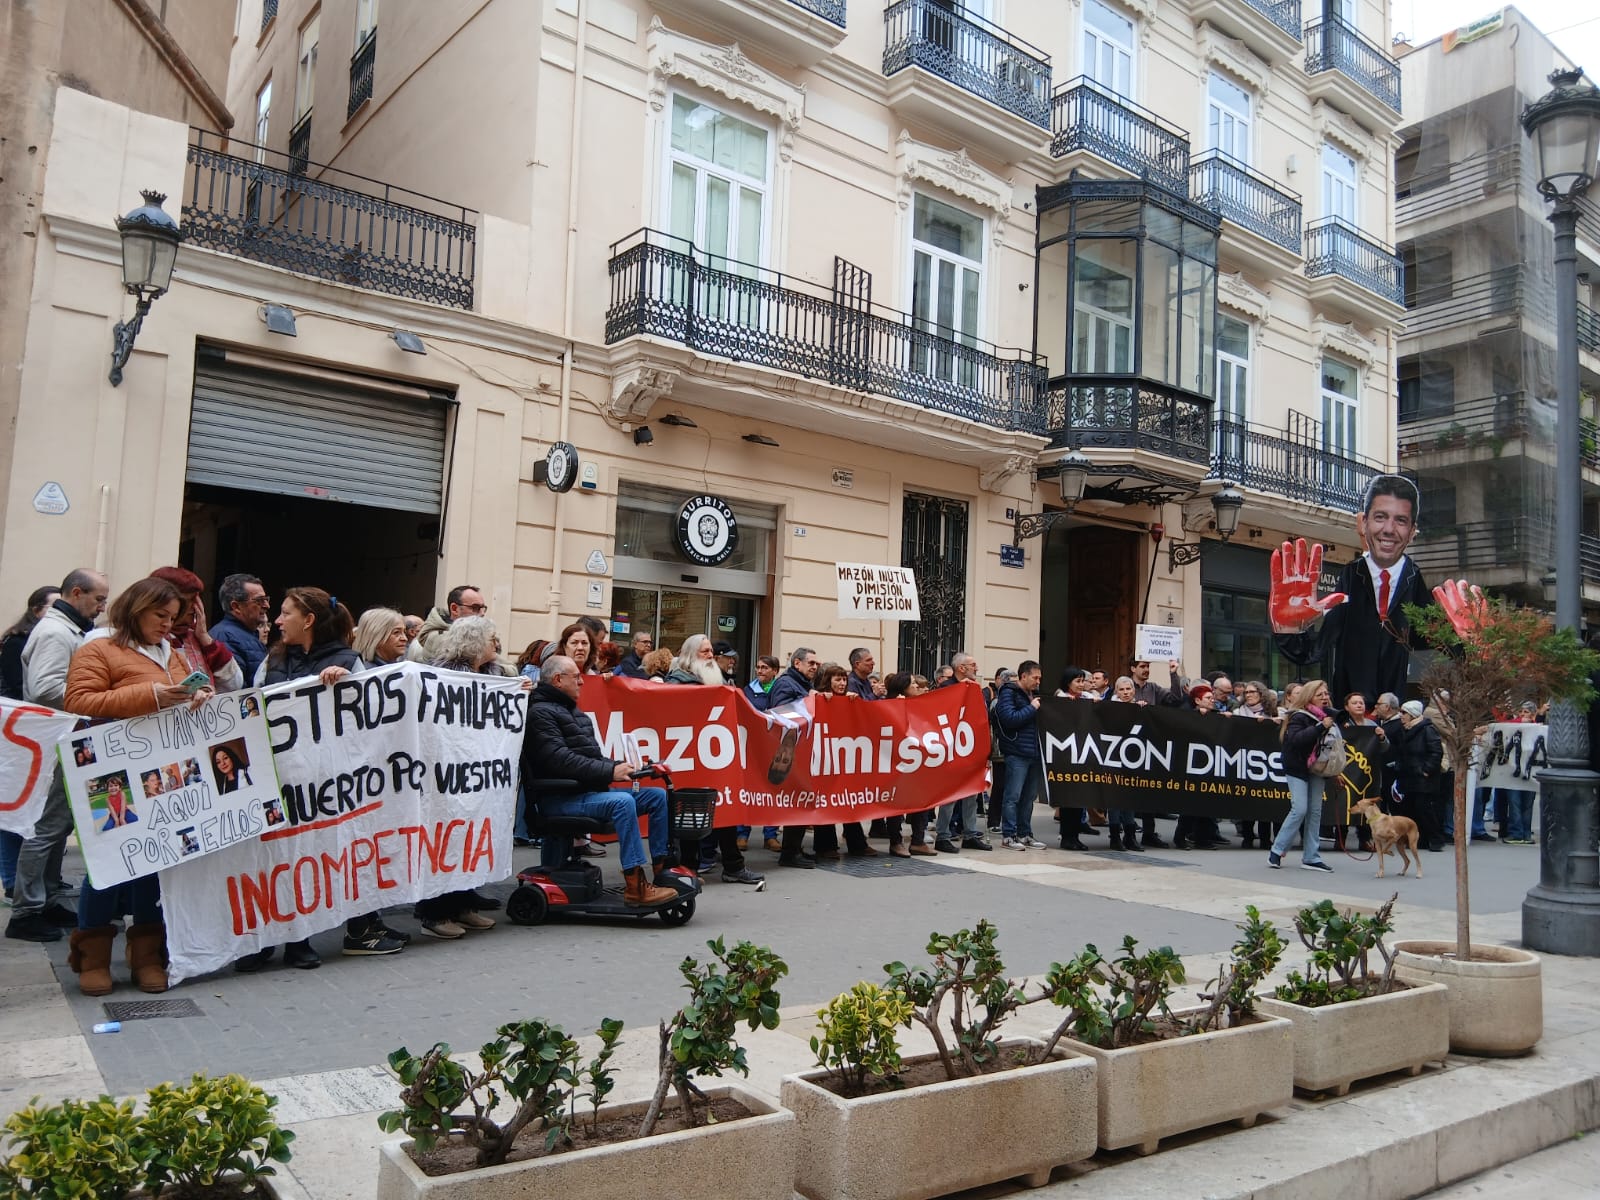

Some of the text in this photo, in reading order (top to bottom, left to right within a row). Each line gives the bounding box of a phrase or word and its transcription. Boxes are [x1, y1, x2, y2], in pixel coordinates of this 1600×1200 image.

[681, 496, 735, 527] BURRITOS
[684, 540, 732, 563] MEXICAN GRILL
[838, 566, 910, 584] MAZÓN INÚTIL
[856, 582, 902, 596] DIMISIÓN
[852, 597, 860, 609] Y
[1150, 639, 1171, 647] VOLEM
[103, 696, 236, 759] ESTAMOS
[264, 672, 406, 755] STROS
[1045, 724, 1287, 783] MAZÓN DIMISS
[434, 758, 512, 795] VUESTRA
[1047, 770, 1112, 785] Associació
[1166, 779, 1180, 790] de
[1184, 780, 1196, 792] la
[1200, 782, 1232, 795] DANA
[1235, 785, 1247, 796] 29
[1250, 788, 1291, 800] octubre
[830, 786, 897, 809] culpable!
[120, 799, 263, 876] POR ELLOS
[226, 817, 495, 936] INCOMPETNCIA
